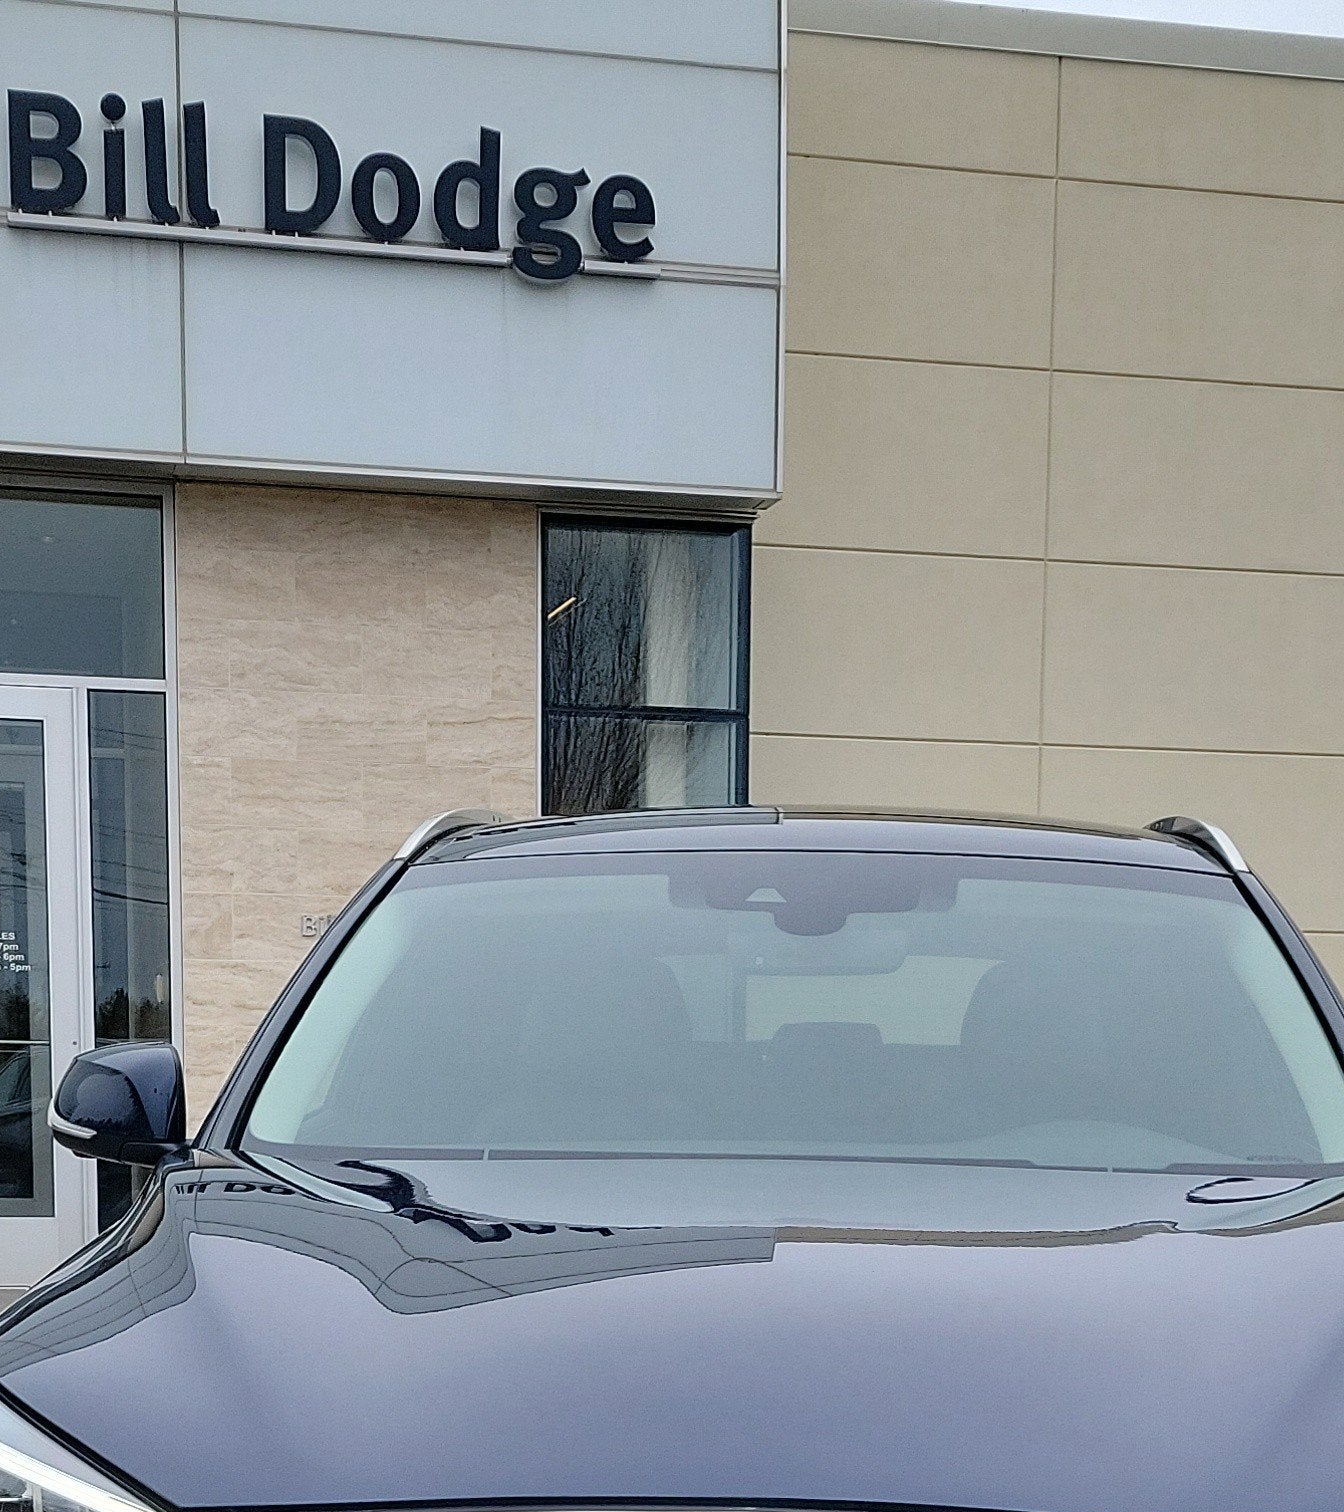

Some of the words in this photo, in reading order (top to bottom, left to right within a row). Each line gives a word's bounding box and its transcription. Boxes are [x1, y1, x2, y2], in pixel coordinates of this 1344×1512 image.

[7, 89, 221, 227] Bill
[262, 112, 657, 283] Dodge
[10, 963, 31, 972] 5pm
